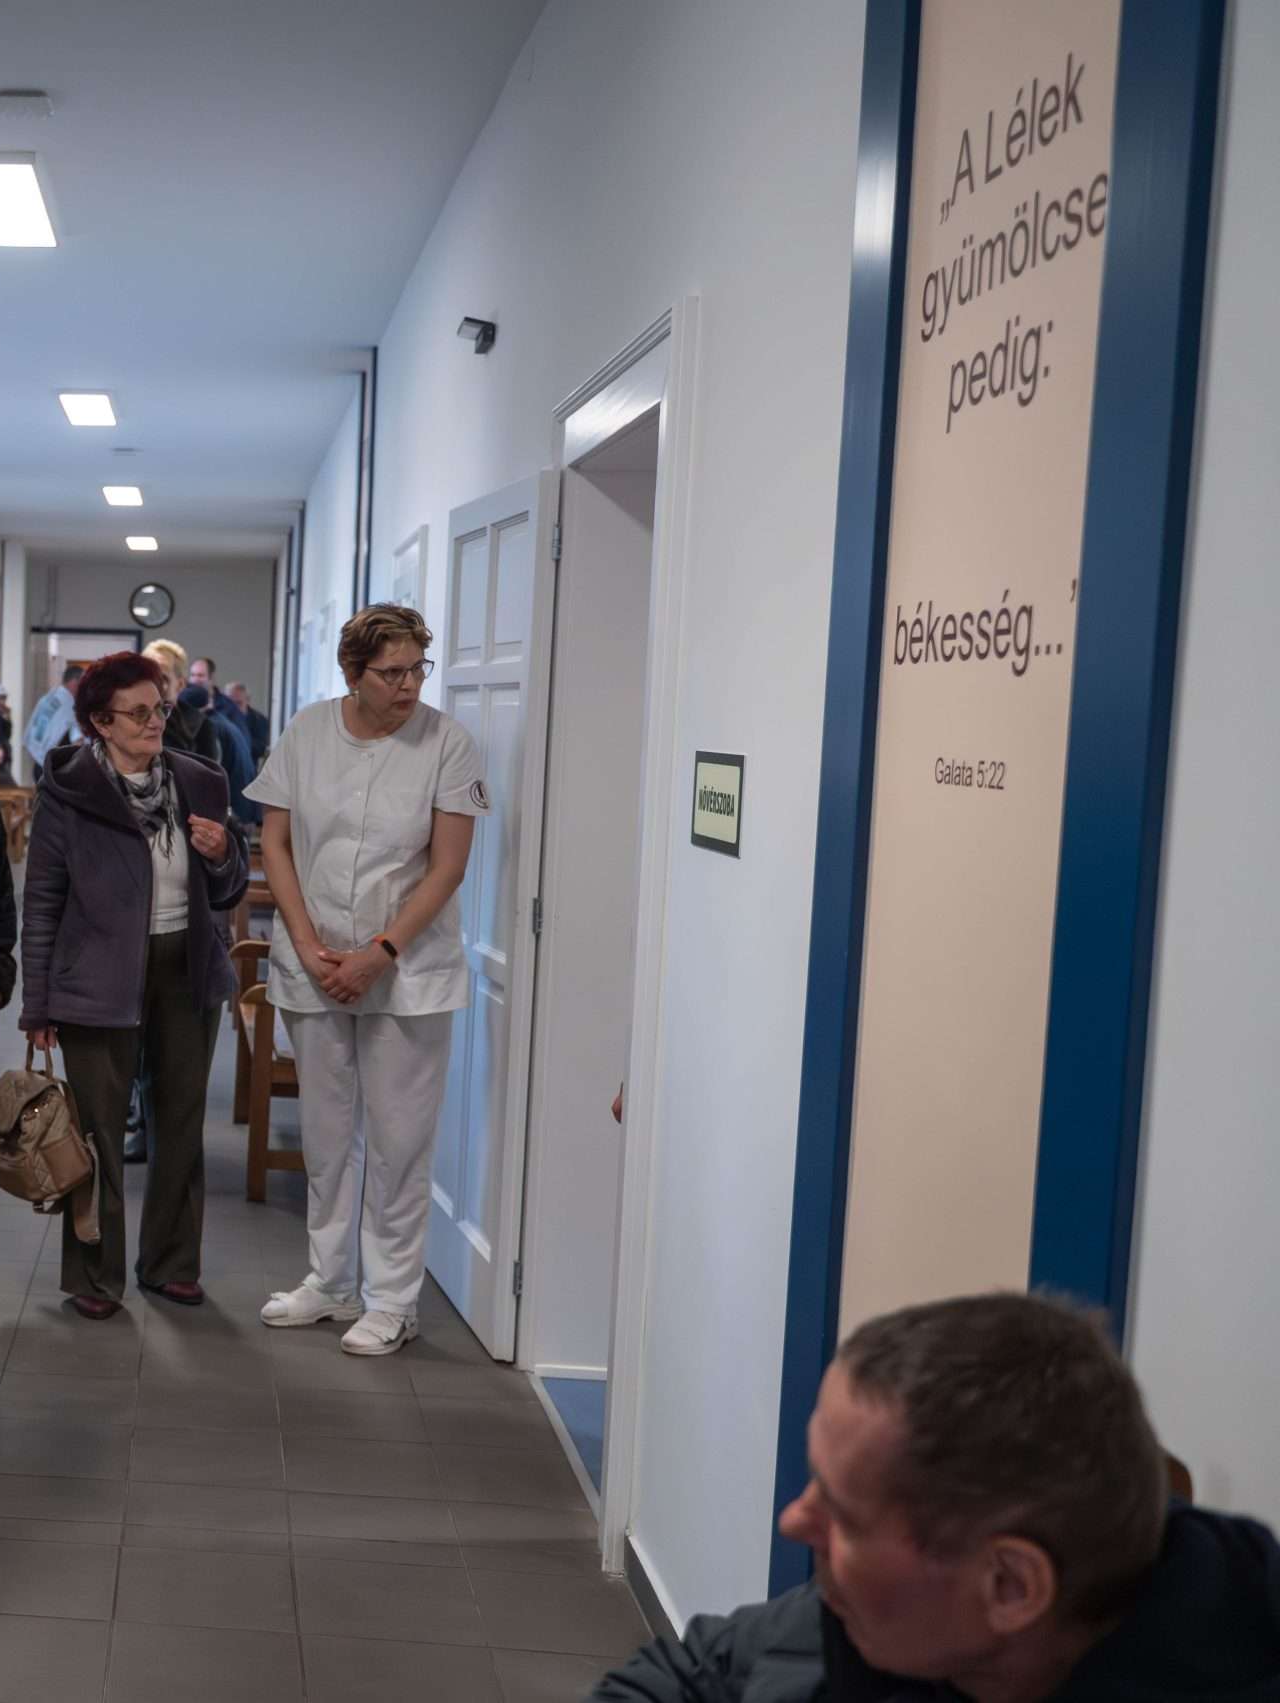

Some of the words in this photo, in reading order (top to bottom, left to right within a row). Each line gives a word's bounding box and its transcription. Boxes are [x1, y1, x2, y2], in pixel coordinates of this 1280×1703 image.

[984, 52, 1085, 184] Lélek
[920, 173, 1108, 343] gyümölcse
[945, 314, 1054, 435] pedig:
[934, 757, 973, 787] Galata
[976, 760, 1006, 790] 5:22
